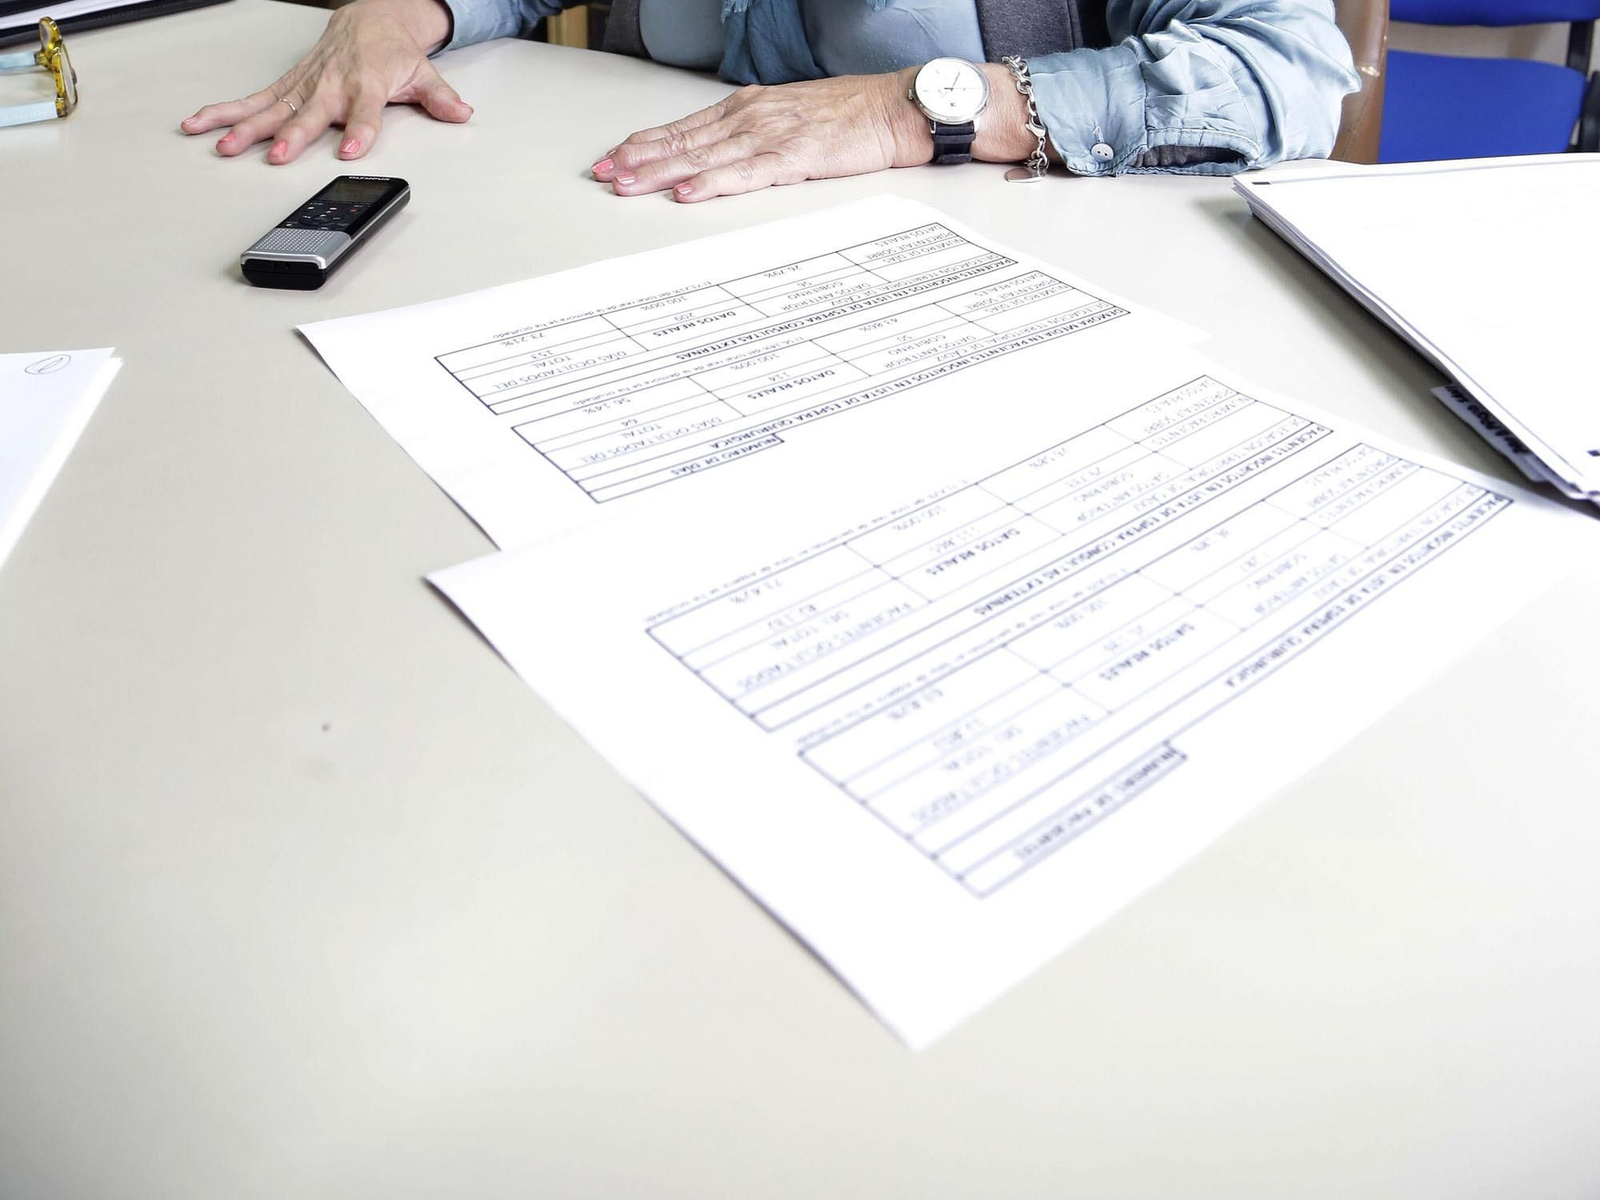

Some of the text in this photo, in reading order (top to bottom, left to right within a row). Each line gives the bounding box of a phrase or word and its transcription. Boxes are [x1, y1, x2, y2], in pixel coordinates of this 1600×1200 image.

[957, 259, 1013, 277] PACIENTES
[784, 281, 844, 299] GOBIERNO
[876, 271, 939, 291] TERRITORIAL
[906, 274, 961, 292] INSCRITOS
[779, 282, 872, 311] DATOS ANTERIOR
[827, 294, 865, 307] CÁDIZ
[861, 295, 893, 306] LISTA
[651, 310, 737, 337] DATOS REALES
[671, 312, 697, 321] 209
[803, 308, 848, 322] ESPERA
[736, 320, 806, 342] CONSULTAS
[674, 339, 738, 360] EXTERNAS
[880, 335, 977, 368] DATOS ANTERIOR
[886, 334, 948, 355] GOBIERNO
[528, 349, 554, 359] 153
[530, 355, 572, 369] TOTAL
[491, 350, 631, 390] DÍAS OCULTADOS DEL
[707, 308, 1125, 449] DEMORA MEDIA EN PACIENTES INSCRITOS EN LISTA DE ESPERA QUIRURGICA
[765, 371, 792, 382] 114
[745, 369, 836, 400] DATOS REALES
[620, 423, 662, 439] TOTAL
